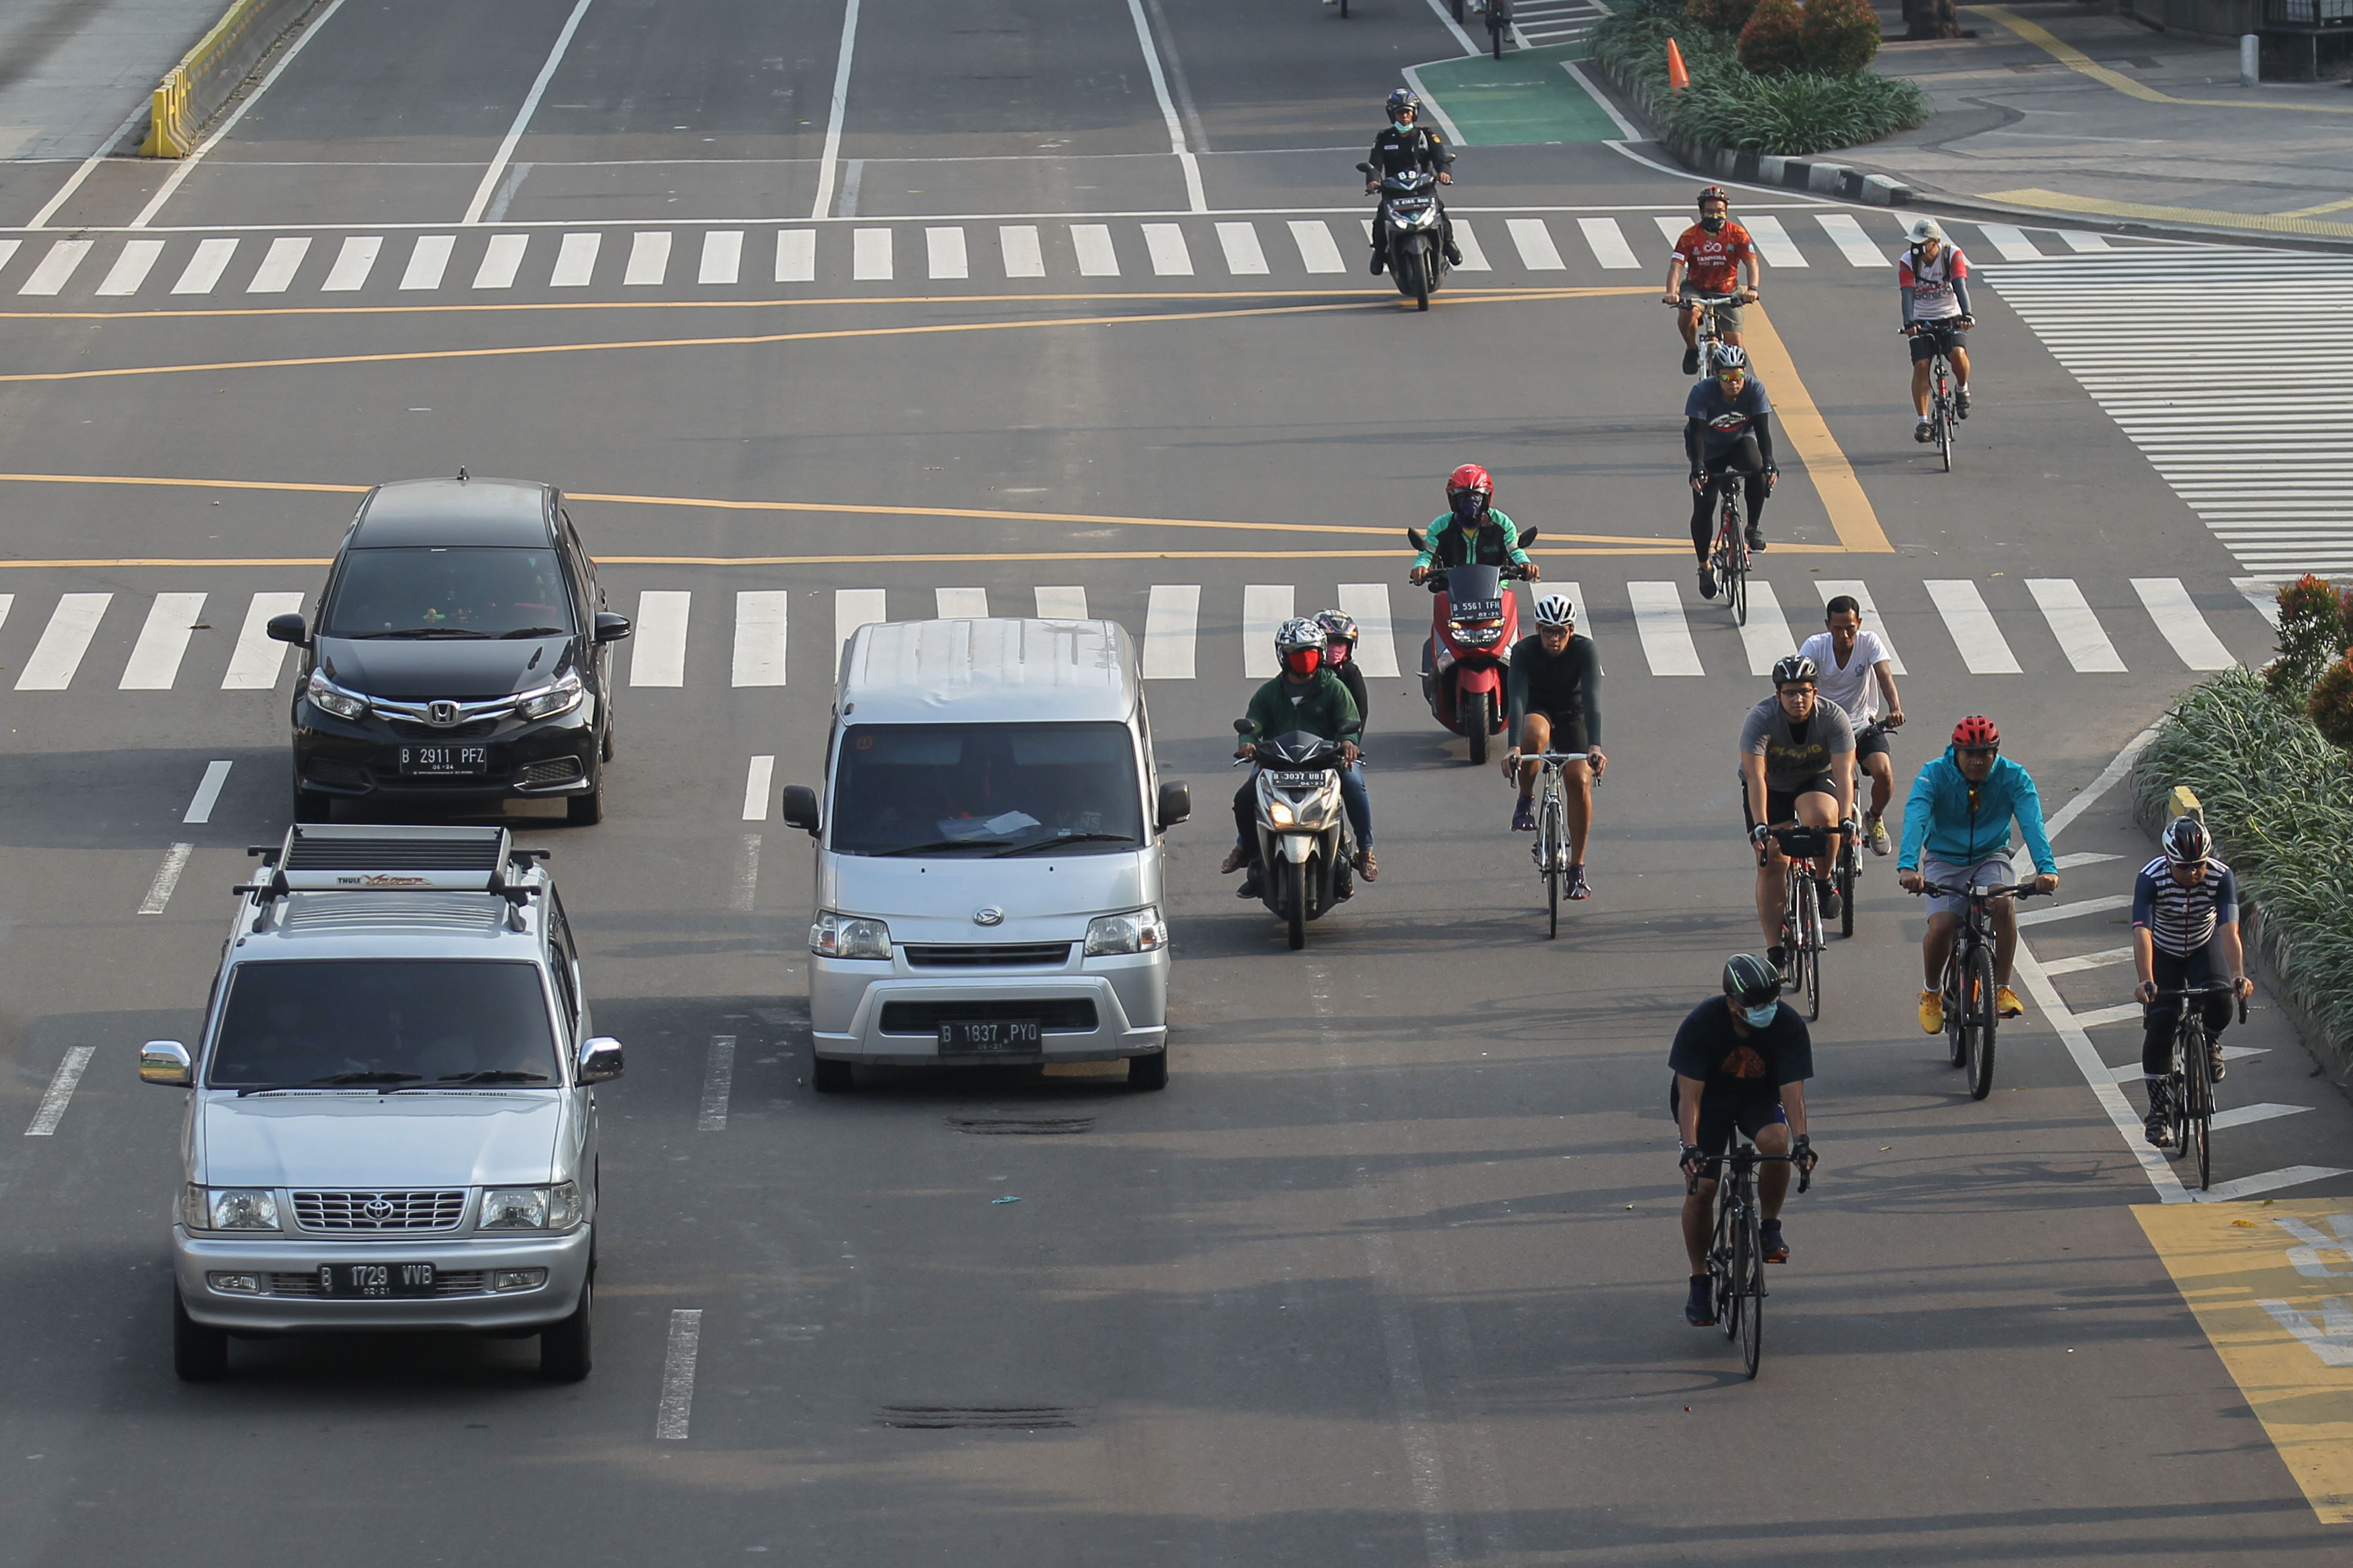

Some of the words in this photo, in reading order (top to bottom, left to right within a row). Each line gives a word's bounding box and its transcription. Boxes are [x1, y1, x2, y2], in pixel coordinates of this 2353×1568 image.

[1462, 602, 1481, 610] 5561
[1485, 601, 1500, 609] TFH
[402, 749, 409, 763] B
[420, 748, 449, 763] 2911
[461, 748, 484, 763] PFZ
[942, 1026, 951, 1042] B
[965, 1025, 998, 1042] 1837
[321, 1267, 332, 1286] B
[351, 1265, 388, 1286] 1729
[402, 1265, 432, 1285] VVB
